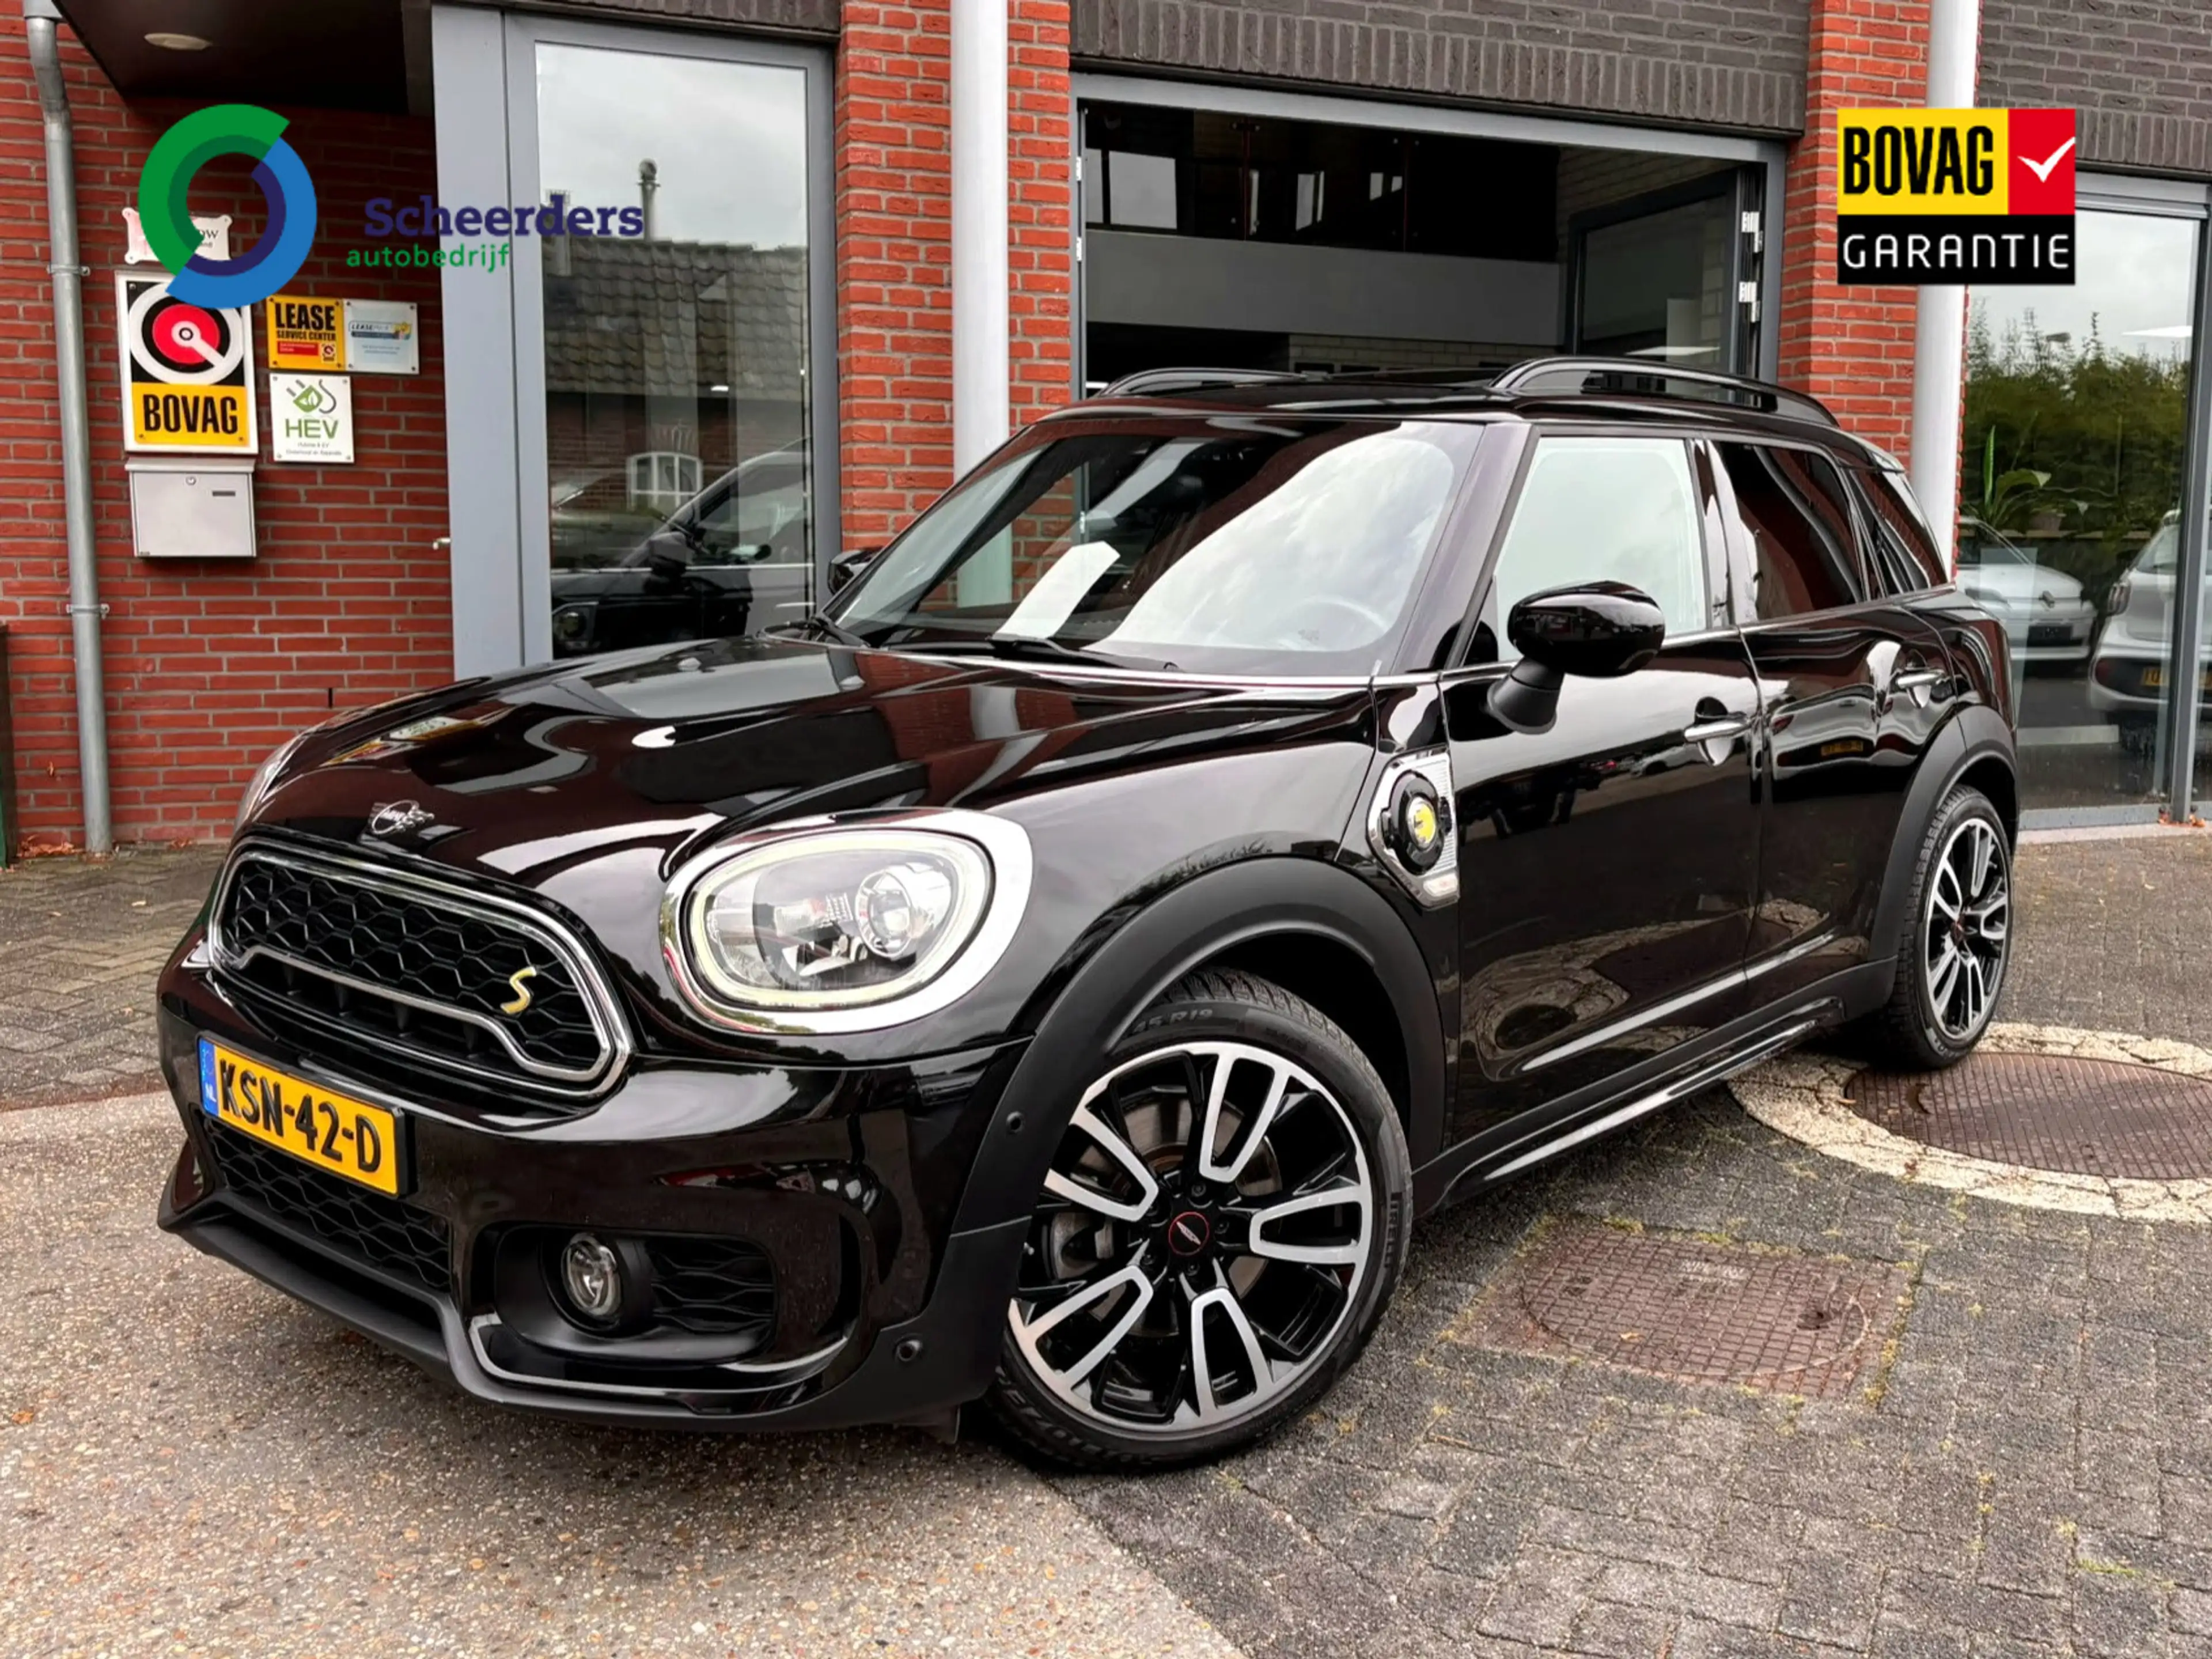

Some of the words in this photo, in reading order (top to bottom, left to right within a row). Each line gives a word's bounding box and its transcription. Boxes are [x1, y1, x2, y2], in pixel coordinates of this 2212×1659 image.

[275, 303, 336, 331] LEASE
[276, 329, 307, 340] SERVICE
[308, 331, 336, 341] CENTER
[143, 394, 238, 434] BOVAG
[285, 418, 339, 439] HEV
[219, 1058, 382, 1174] KSN-42-D
